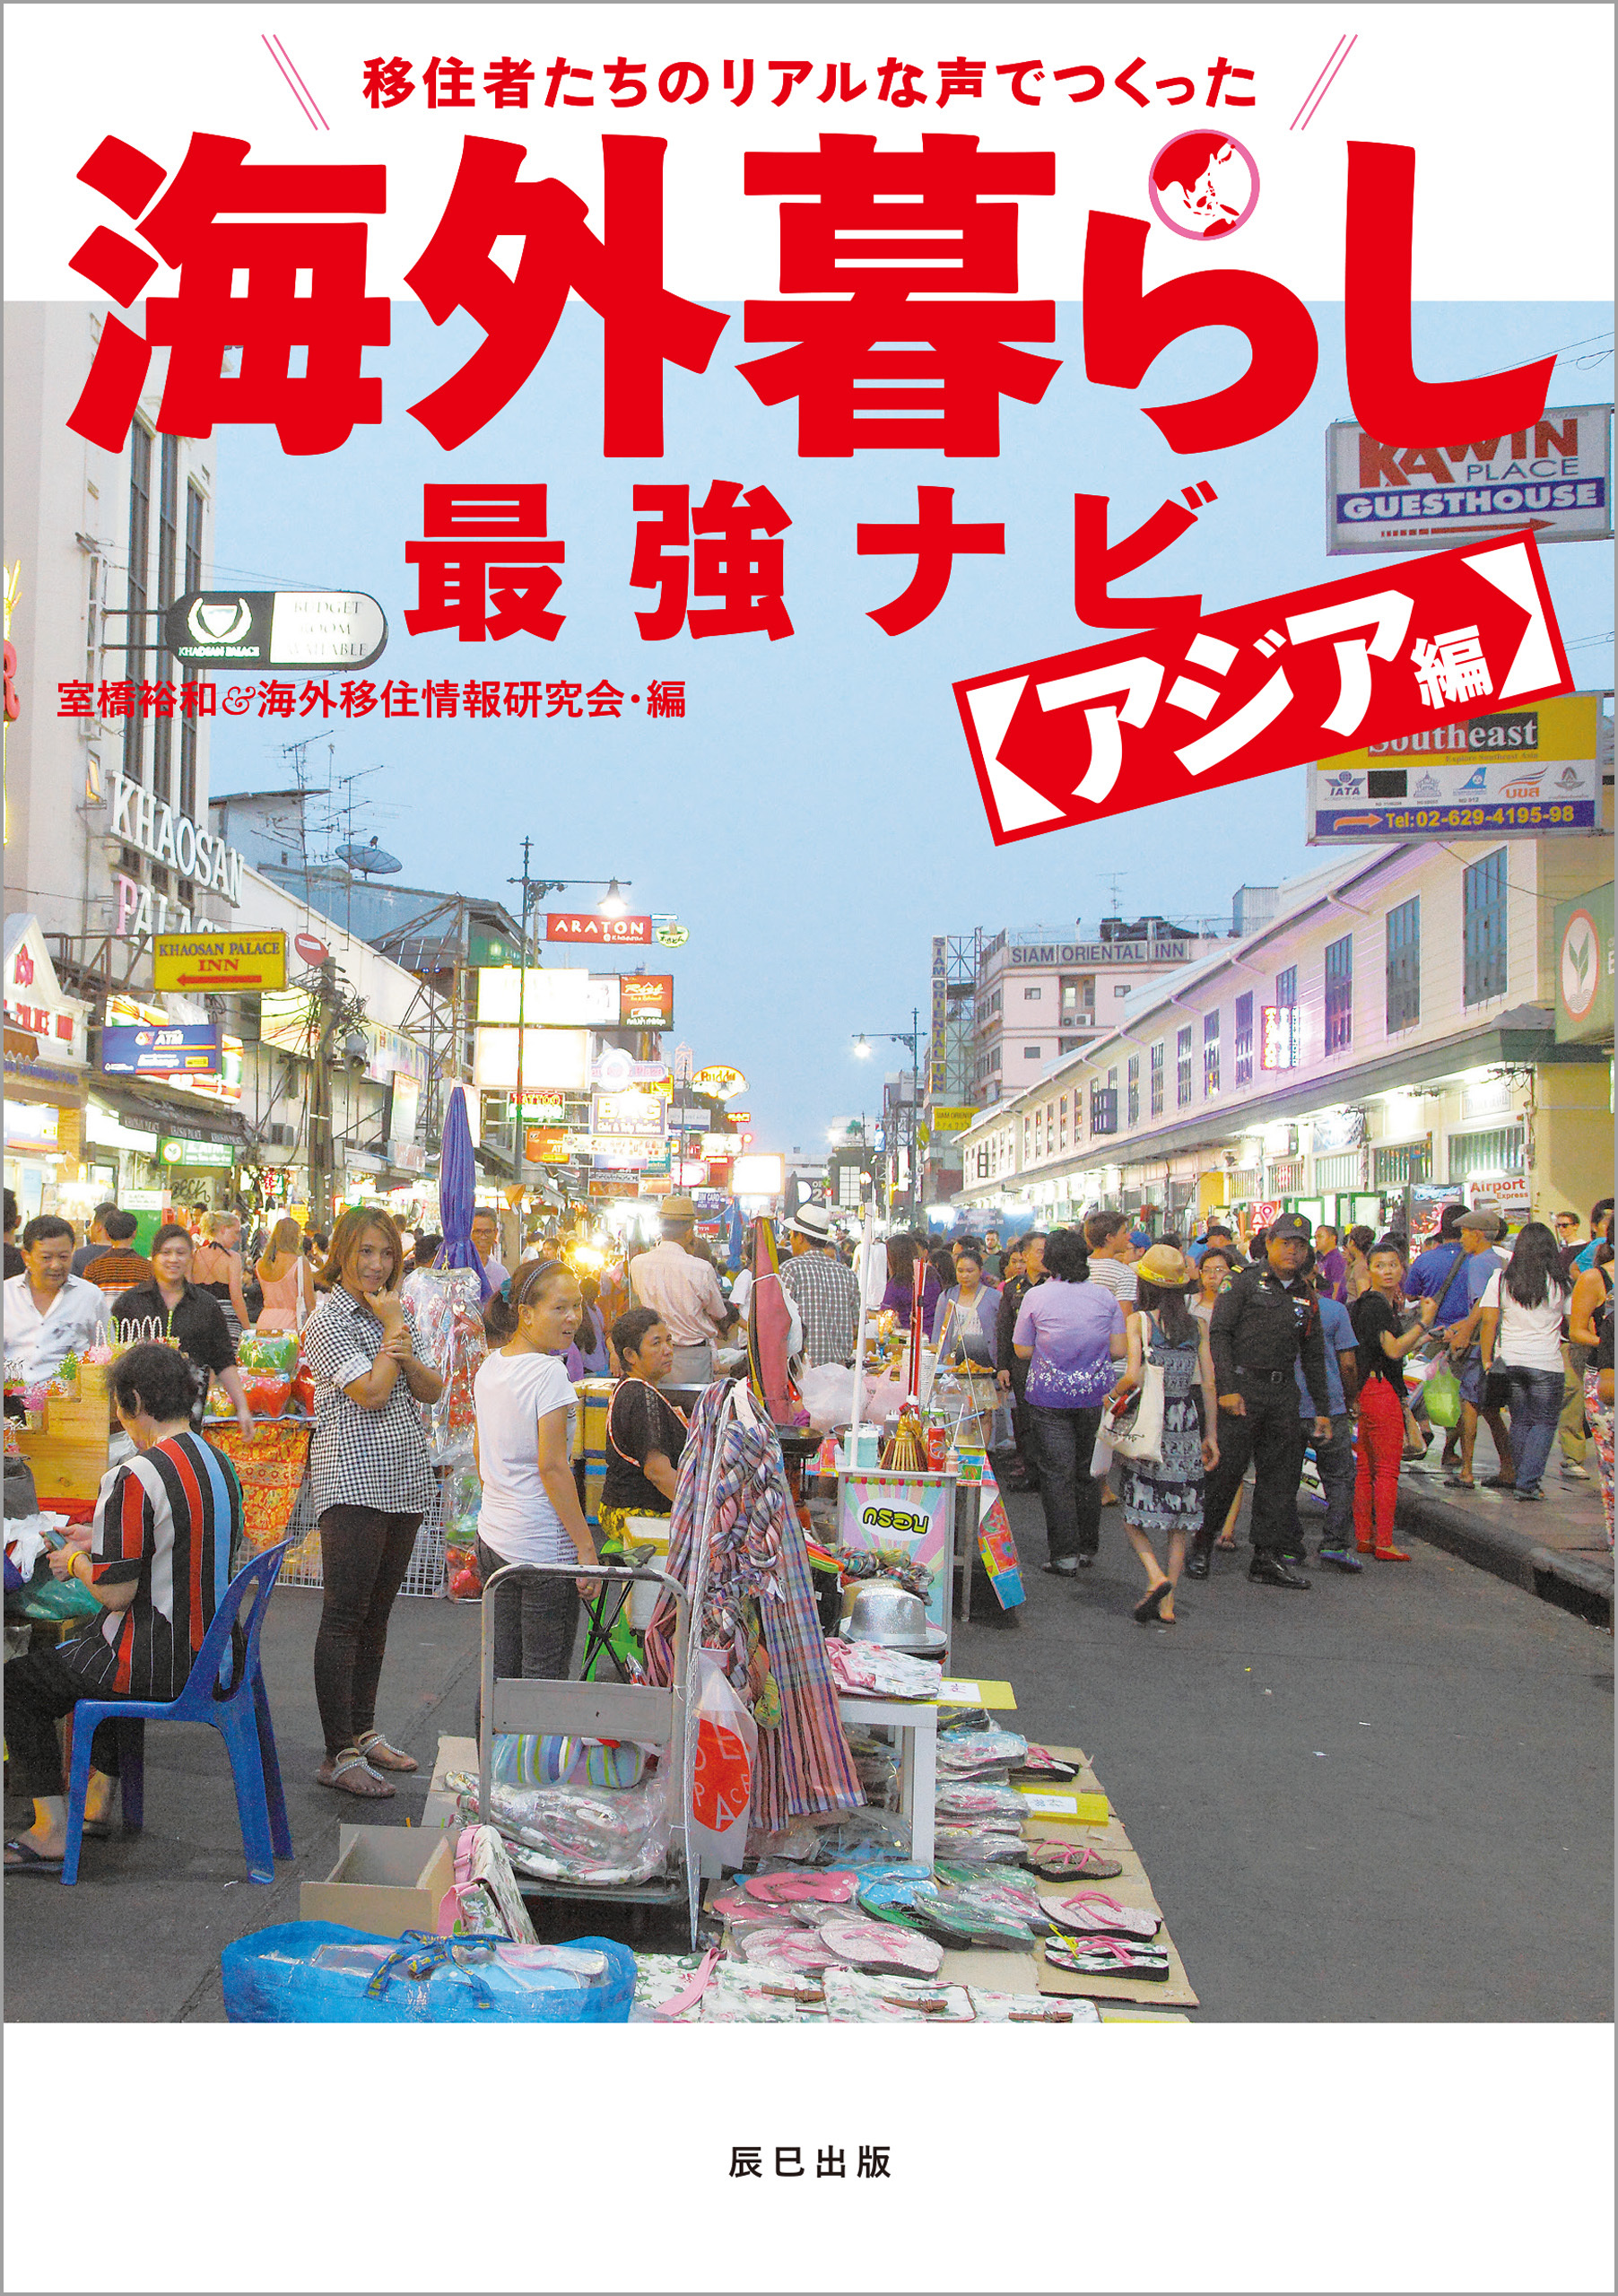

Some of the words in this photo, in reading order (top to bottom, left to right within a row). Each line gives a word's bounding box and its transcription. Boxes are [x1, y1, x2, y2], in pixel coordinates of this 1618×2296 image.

[1467, 457, 1579, 482] PLACE
[1343, 483, 1597, 520] GUESTHOUSE
[1330, 787, 1361, 796] IATA
[110, 770, 245, 907] KHAOSAN
[554, 919, 644, 935] ARATON
[159, 944, 224, 957] KHAOSAN
[229, 943, 280, 956] PALACE
[933, 937, 945, 975] SIAM
[1012, 947, 1054, 963] SIAM
[1062, 944, 1144, 961] ORIENTAL
[1155, 943, 1184, 958] INN
[198, 959, 239, 971] INN
[932, 979, 945, 1057] ORIENTAL
[933, 1064, 944, 1091] INN
[1471, 1178, 1526, 1193] Airport
[1496, 1191, 1528, 1200] Express
[863, 1507, 929, 1535] กรอบ
